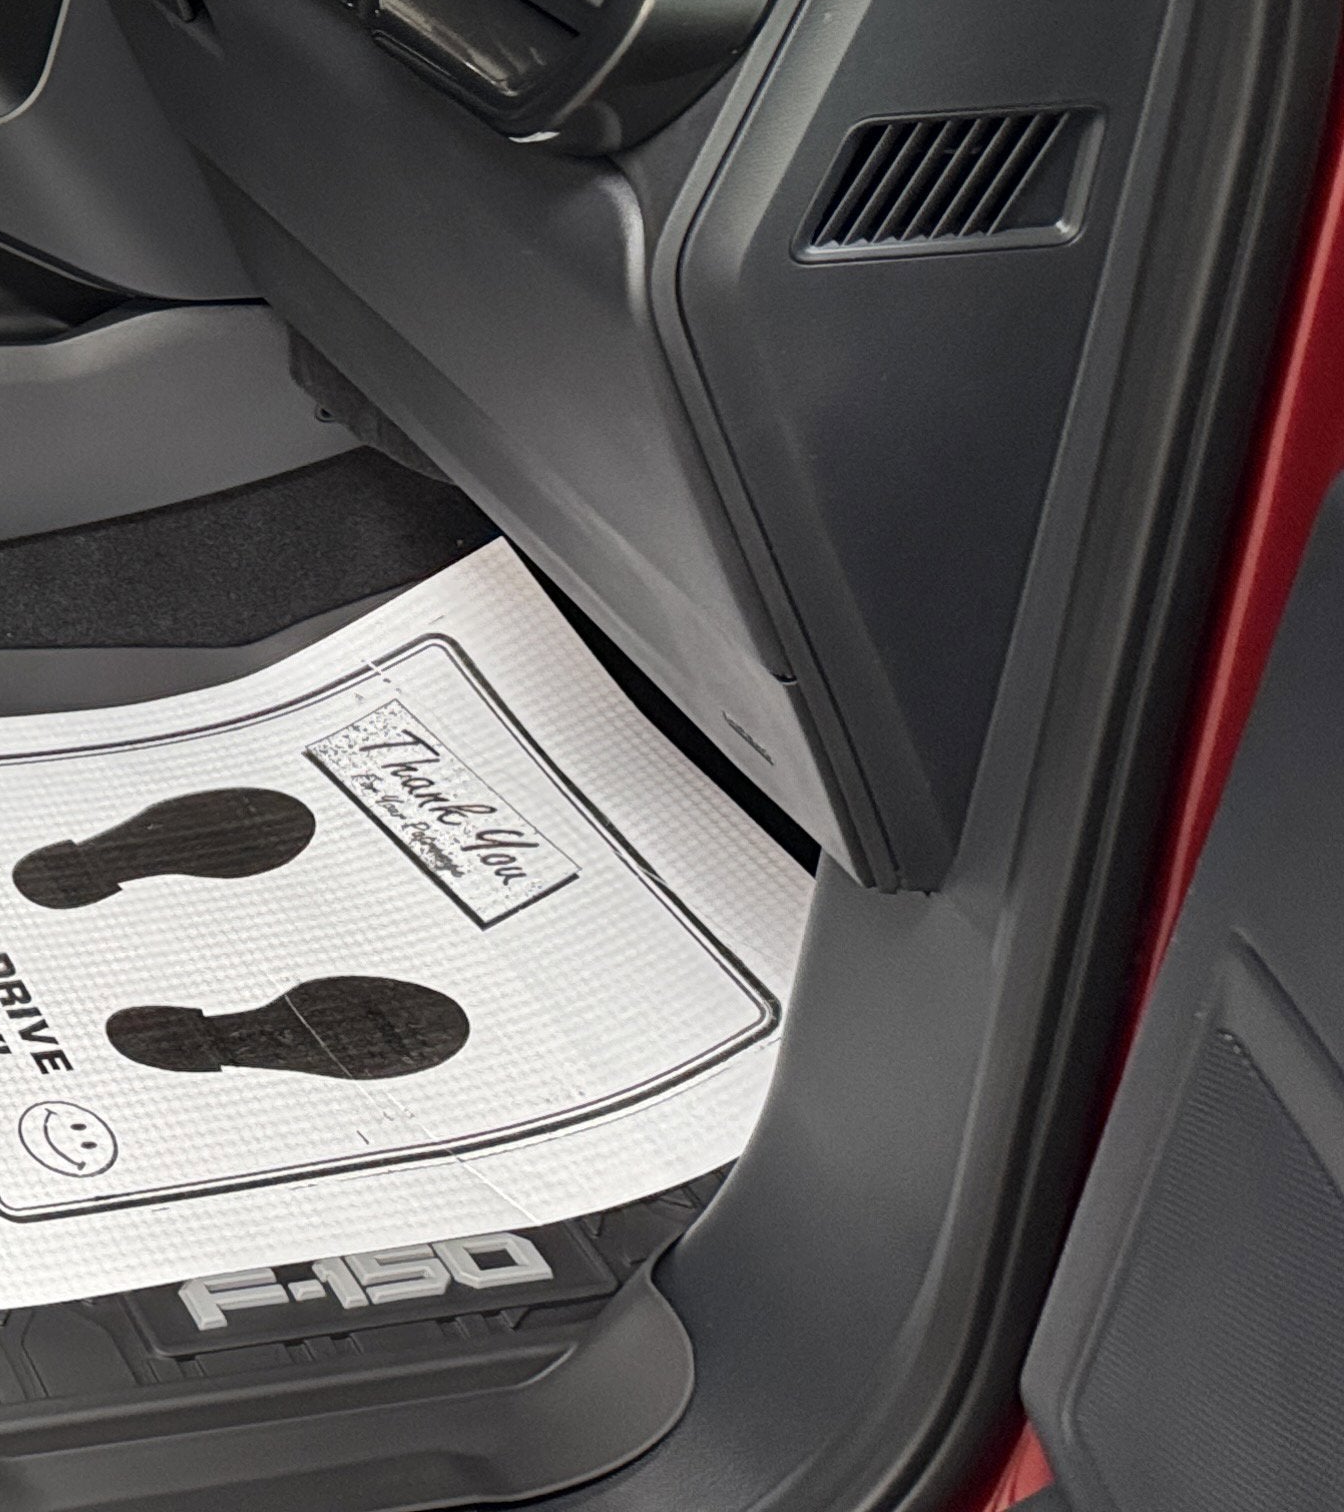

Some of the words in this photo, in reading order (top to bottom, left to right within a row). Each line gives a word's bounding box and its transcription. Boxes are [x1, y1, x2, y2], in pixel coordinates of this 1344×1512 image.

[359, 729, 498, 826] Thank
[461, 829, 540, 886] You
[178, 1232, 554, 1331] F-150
